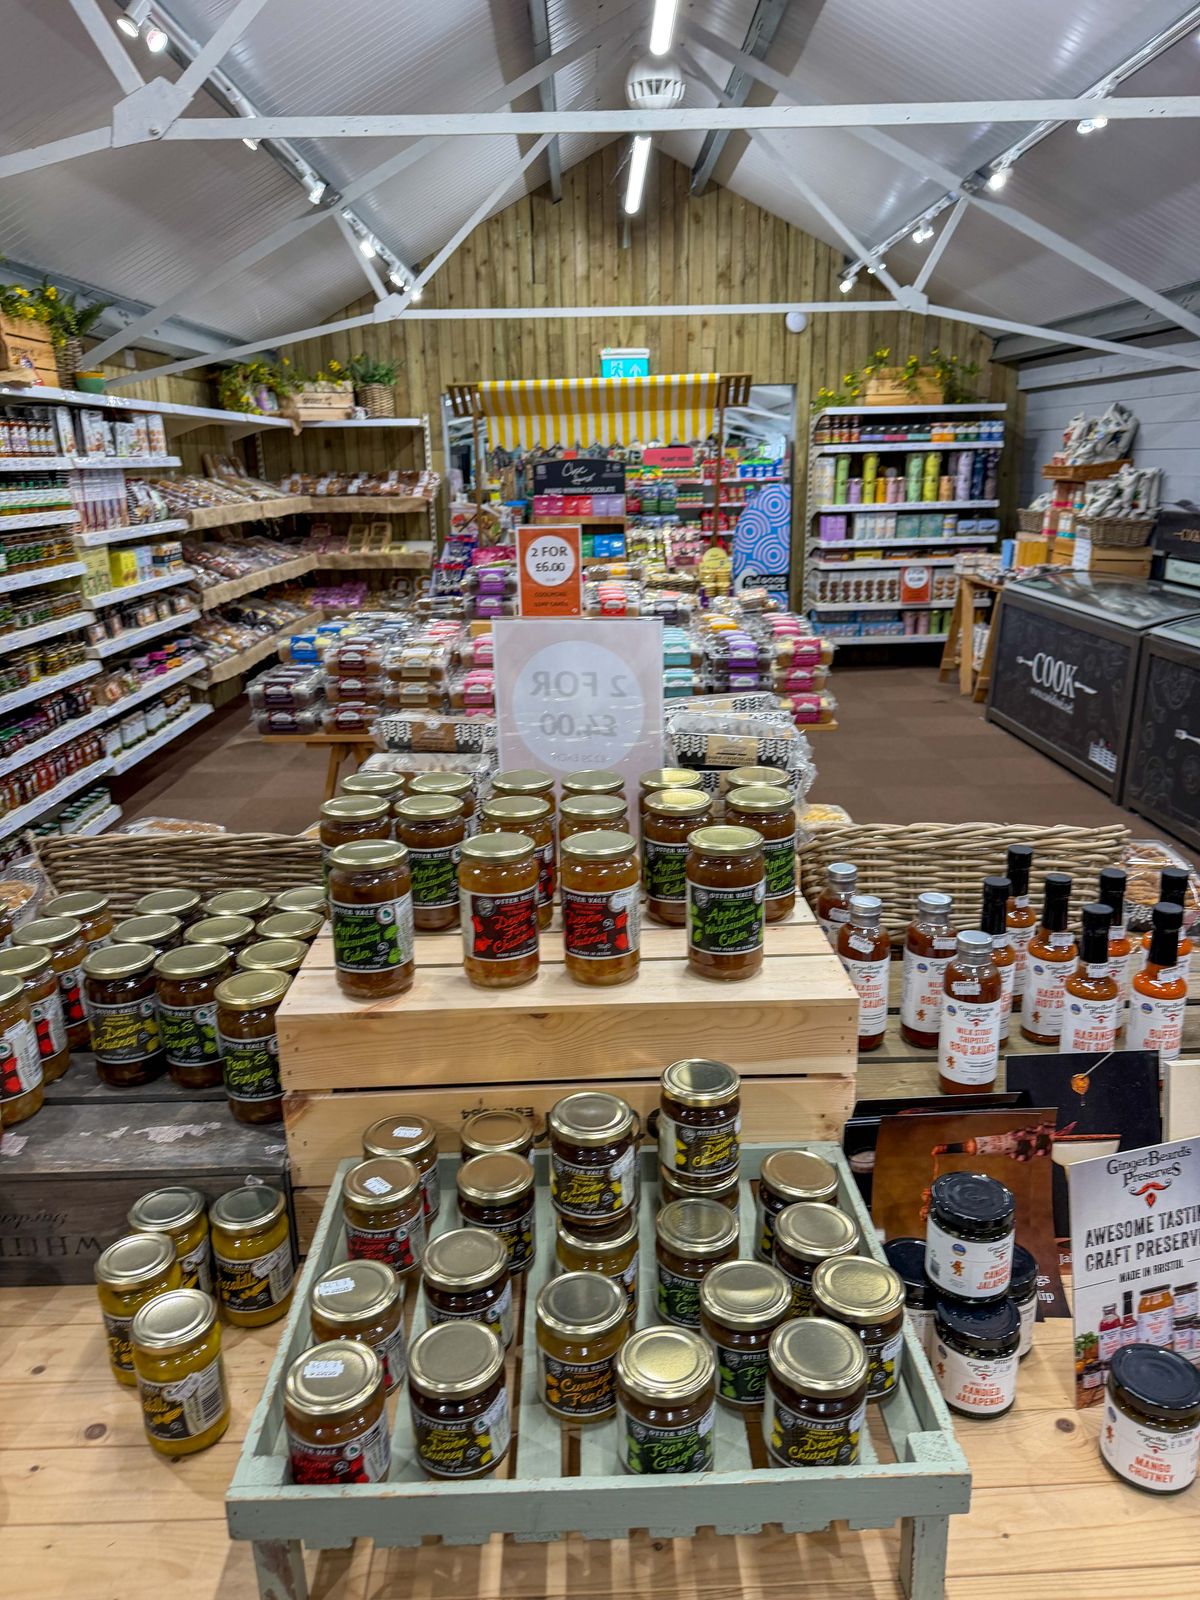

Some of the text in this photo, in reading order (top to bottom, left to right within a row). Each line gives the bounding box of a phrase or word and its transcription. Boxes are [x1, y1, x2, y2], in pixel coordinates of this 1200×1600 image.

[531, 546, 568, 557] 2 FOR
[535, 562, 566, 572] £6.00
[1032, 652, 1078, 698] COOK
[495, 897, 519, 905] OTTER
[587, 896, 607, 904] VALE
[709, 890, 753, 900] OTTER VALE
[706, 907, 740, 926] Apple
[718, 930, 750, 947] Cider
[226, 1050, 269, 1071] Pear &
[228, 1068, 273, 1091] Ginger
[1085, 1215, 1155, 1249] AWESOME
[1085, 1228, 1200, 1273] CRAFT PRESERV
[1119, 1259, 1184, 1284] MADE IN BRISTOL
[564, 1364, 589, 1372] OTTER
[445, 1423, 467, 1431] VALE
[648, 1425, 697, 1437] OTTER VALE
[796, 1419, 846, 1429] OTTER VALE
[643, 1442, 686, 1457] Pear
[800, 1435, 849, 1452] Devon
[652, 1444, 700, 1470] Ginger
[787, 1445, 838, 1462] Chutney
[1134, 1456, 1172, 1473] MANGO
[1128, 1464, 1175, 1483] CHUTNEY
